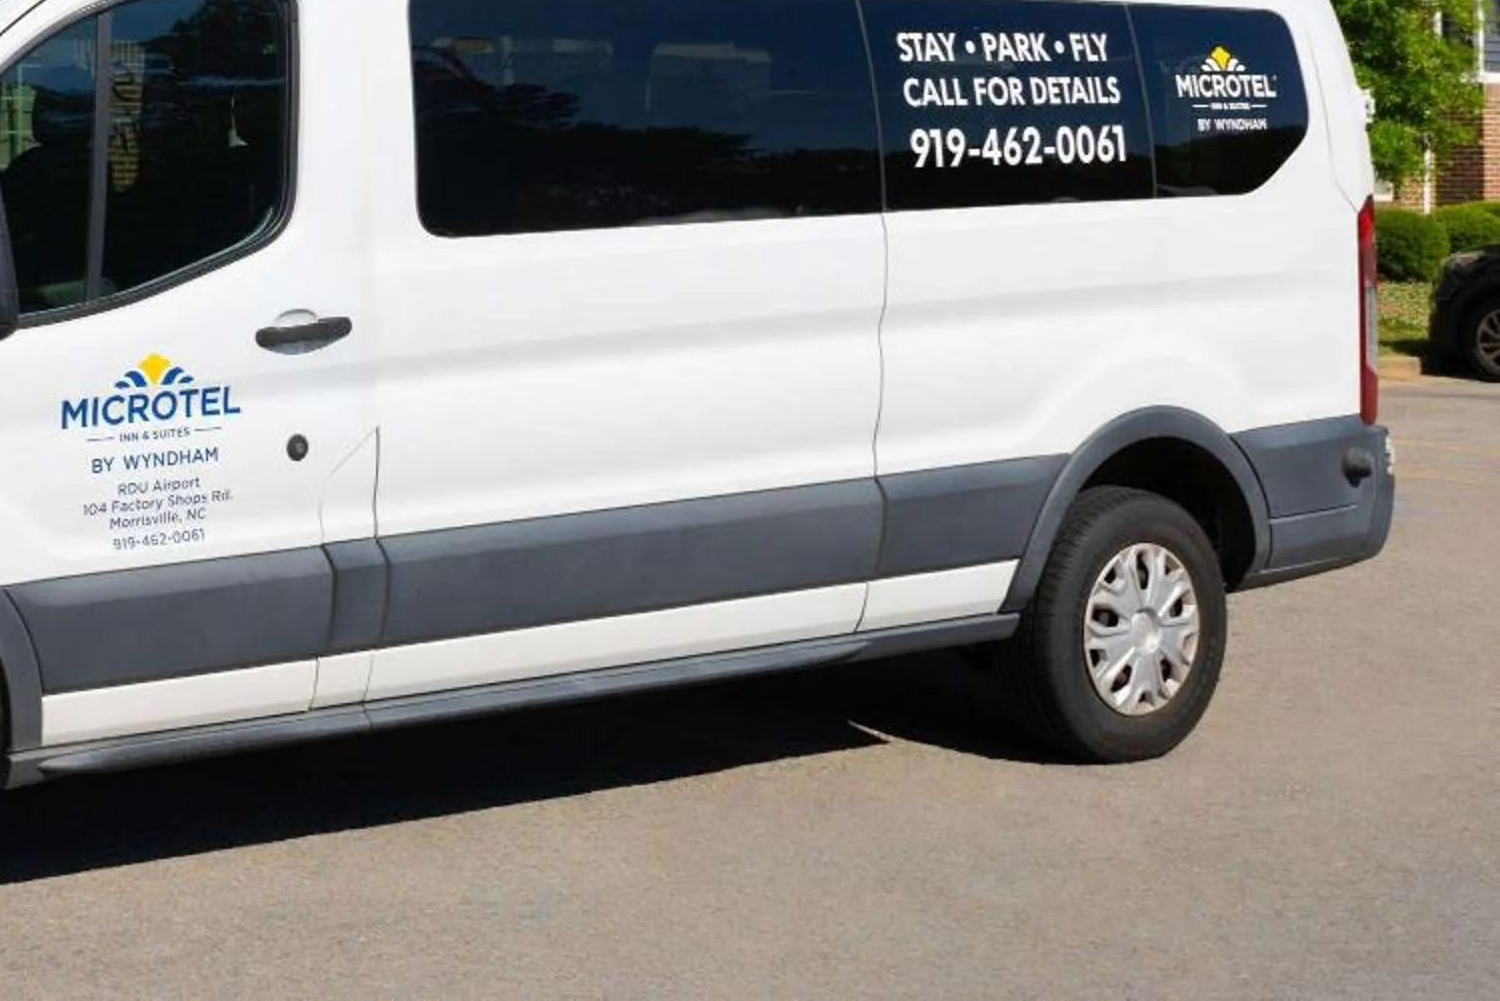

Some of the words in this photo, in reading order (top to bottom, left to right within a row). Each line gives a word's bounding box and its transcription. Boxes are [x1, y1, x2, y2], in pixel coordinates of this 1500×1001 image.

[897, 32, 956, 62] STAY
[983, 32, 1051, 62] PARK
[1069, 33, 1108, 61] FLY
[903, 77, 968, 107] CALL
[974, 78, 1024, 106] FOR
[1030, 77, 1121, 105] DETAILS
[1175, 74, 1277, 97] MICROTEL
[1197, 118, 1211, 131] BY
[1214, 118, 1268, 130] WYNDHAM
[910, 125, 1127, 168] 919-462-0061
[61, 386, 241, 429] MICROTEL
[119, 432, 139, 442] INN
[142, 431, 150, 440] &
[153, 427, 191, 439] SUITES
[91, 456, 115, 474] BY
[123, 447, 219, 470] WYNDHAM
[117, 483, 148, 496] RDU
[153, 477, 200, 493] Airport
[83, 502, 107, 516] 104
[111, 499, 163, 514] Factory
[168, 493, 208, 507] Shops
[187, 508, 207, 520] NC
[113, 529, 205, 550] 919-462-0061
